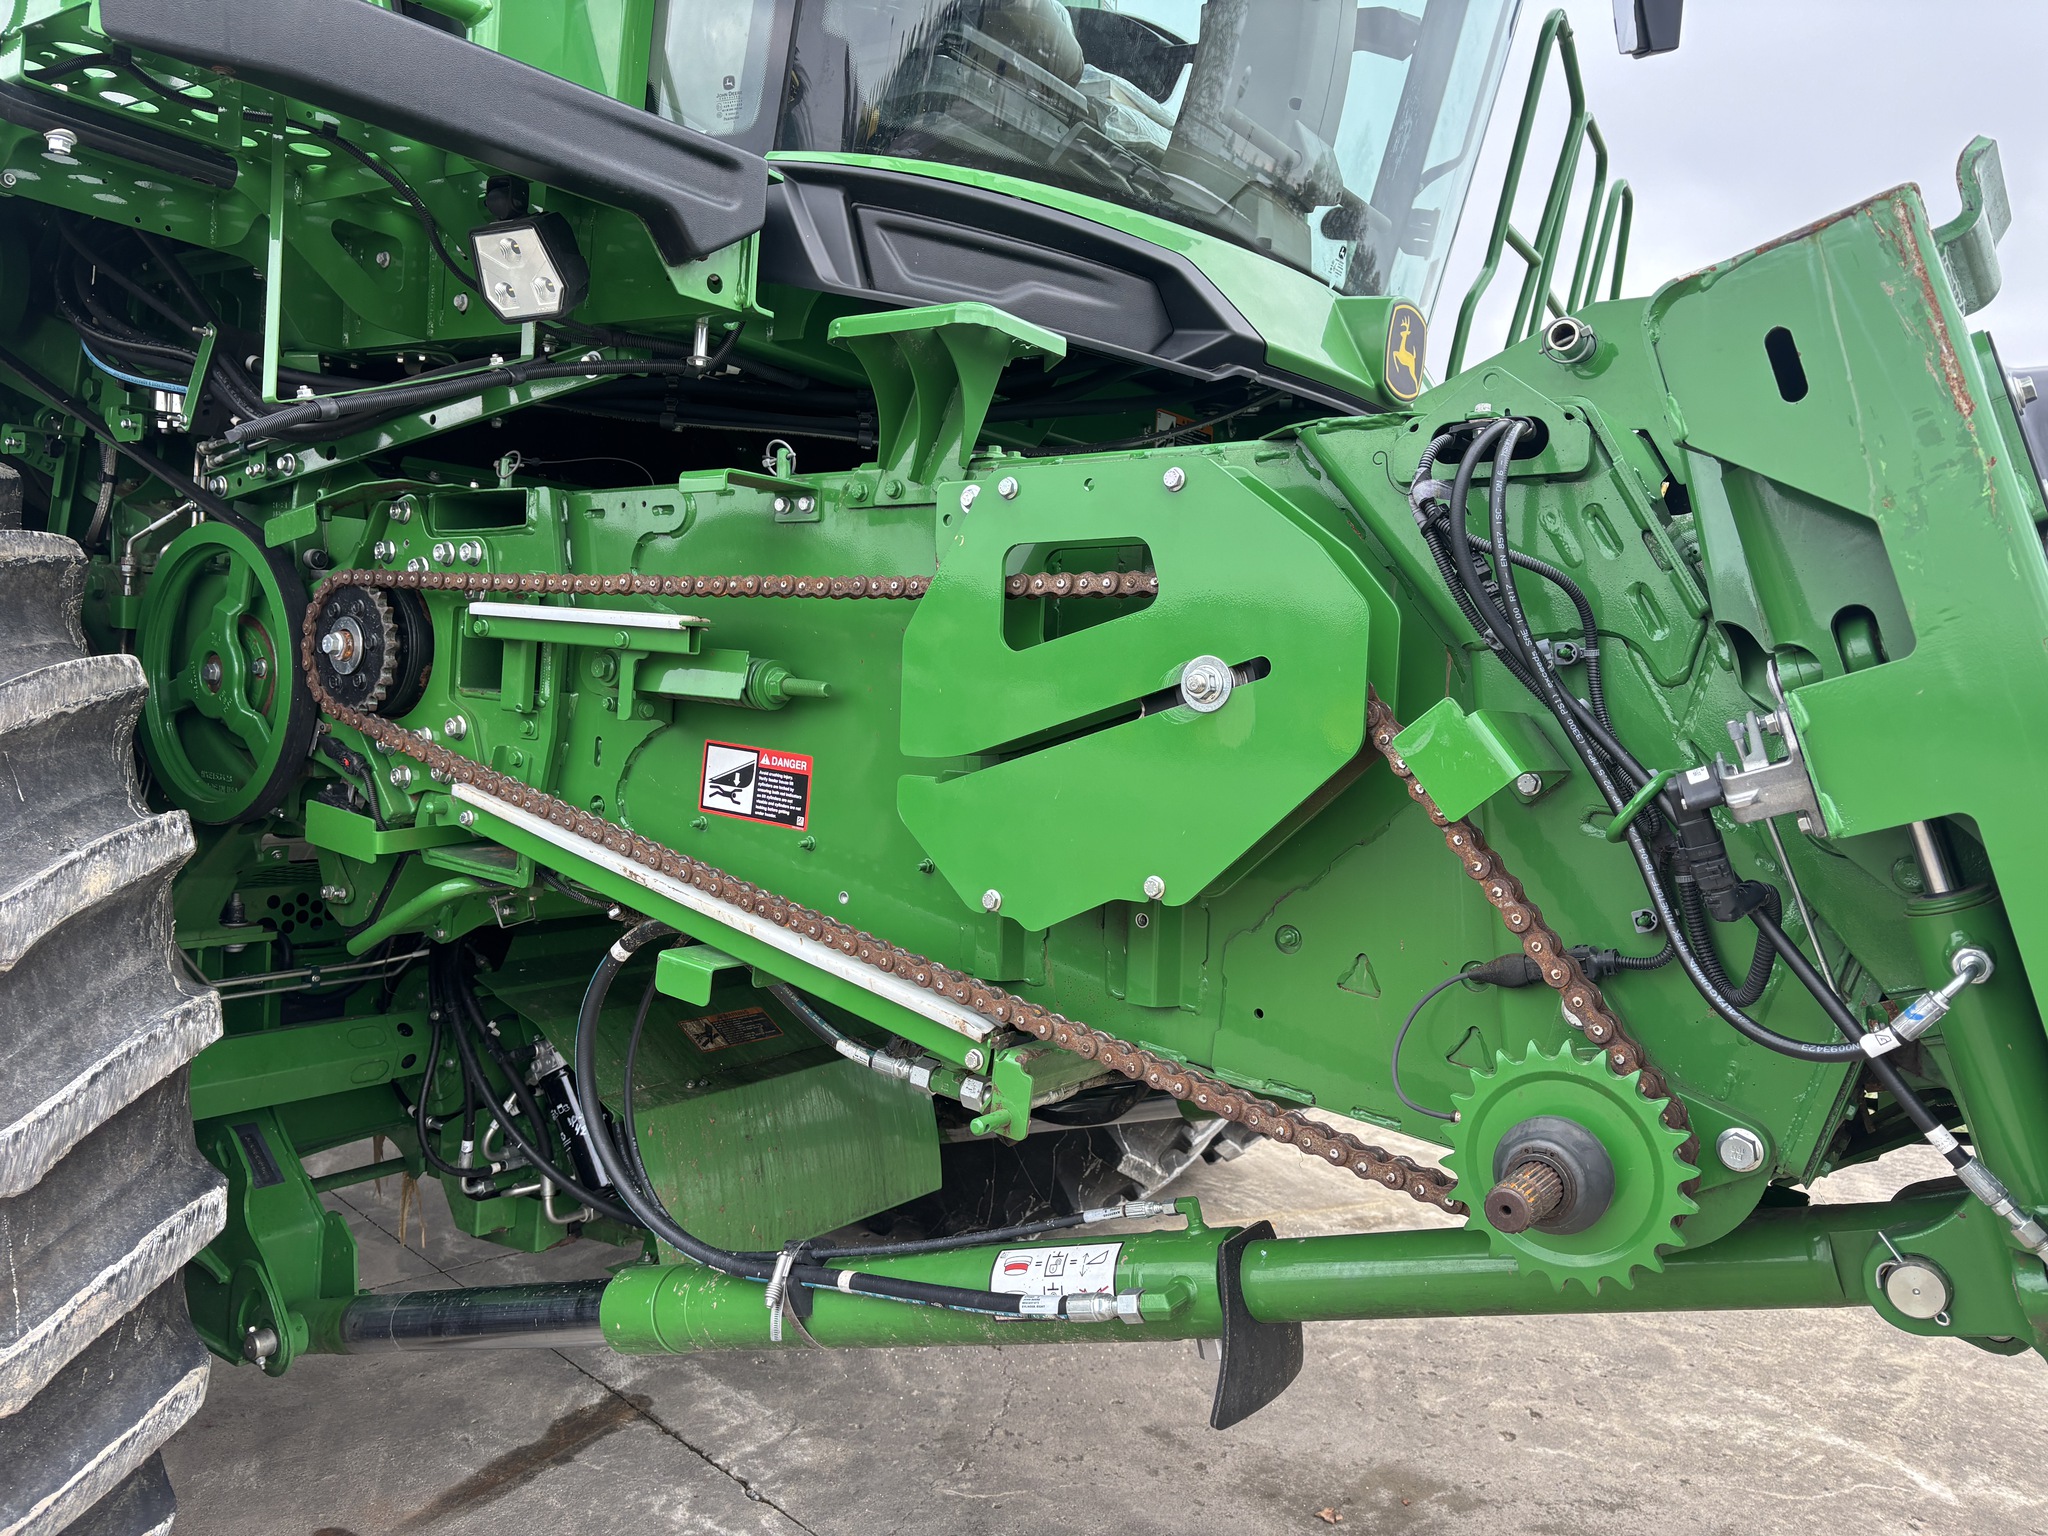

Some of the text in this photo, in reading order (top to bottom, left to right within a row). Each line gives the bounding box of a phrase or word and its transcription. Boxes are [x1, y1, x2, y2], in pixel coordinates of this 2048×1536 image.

[1496, 481, 1503, 492] DN
[1497, 532, 1505, 549] 857
[1500, 555, 1507, 567] EN
[1506, 584, 1517, 602] R17
[1512, 607, 1524, 624] 100
[1520, 629, 1532, 647] SAE
[1531, 650, 1554, 688] exceeds
[772, 756, 807, 771] DANGER
[1586, 749, 1599, 766] MPa
[1801, 1043, 1860, 1054] N0093423
